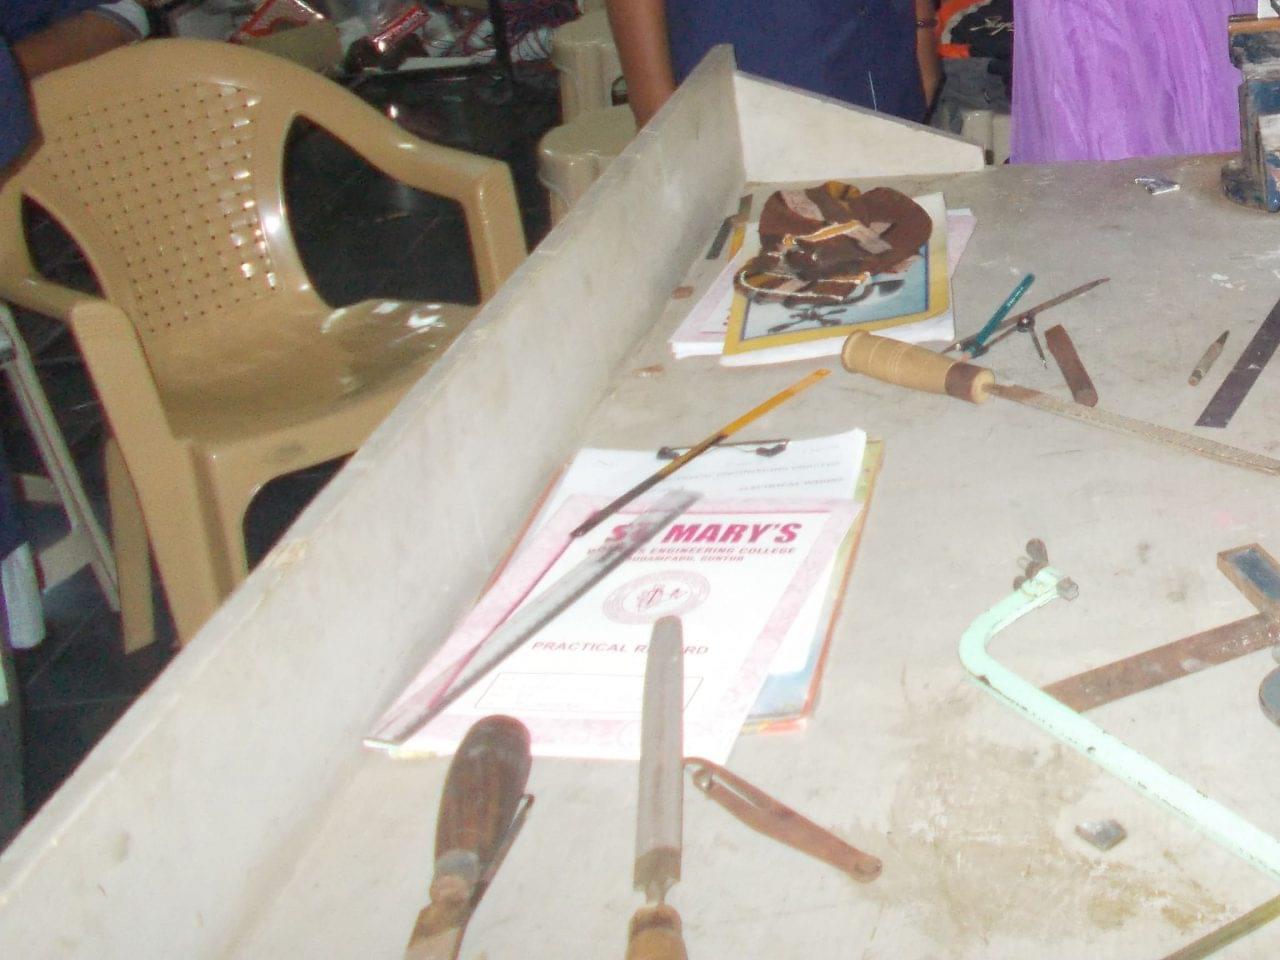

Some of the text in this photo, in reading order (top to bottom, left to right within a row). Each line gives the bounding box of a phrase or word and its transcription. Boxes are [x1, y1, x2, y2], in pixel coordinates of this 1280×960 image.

[661, 522, 802, 544] MARY'S
[739, 546, 797, 555] COLLEGE
[531, 640, 627, 653] PRACTICAL
